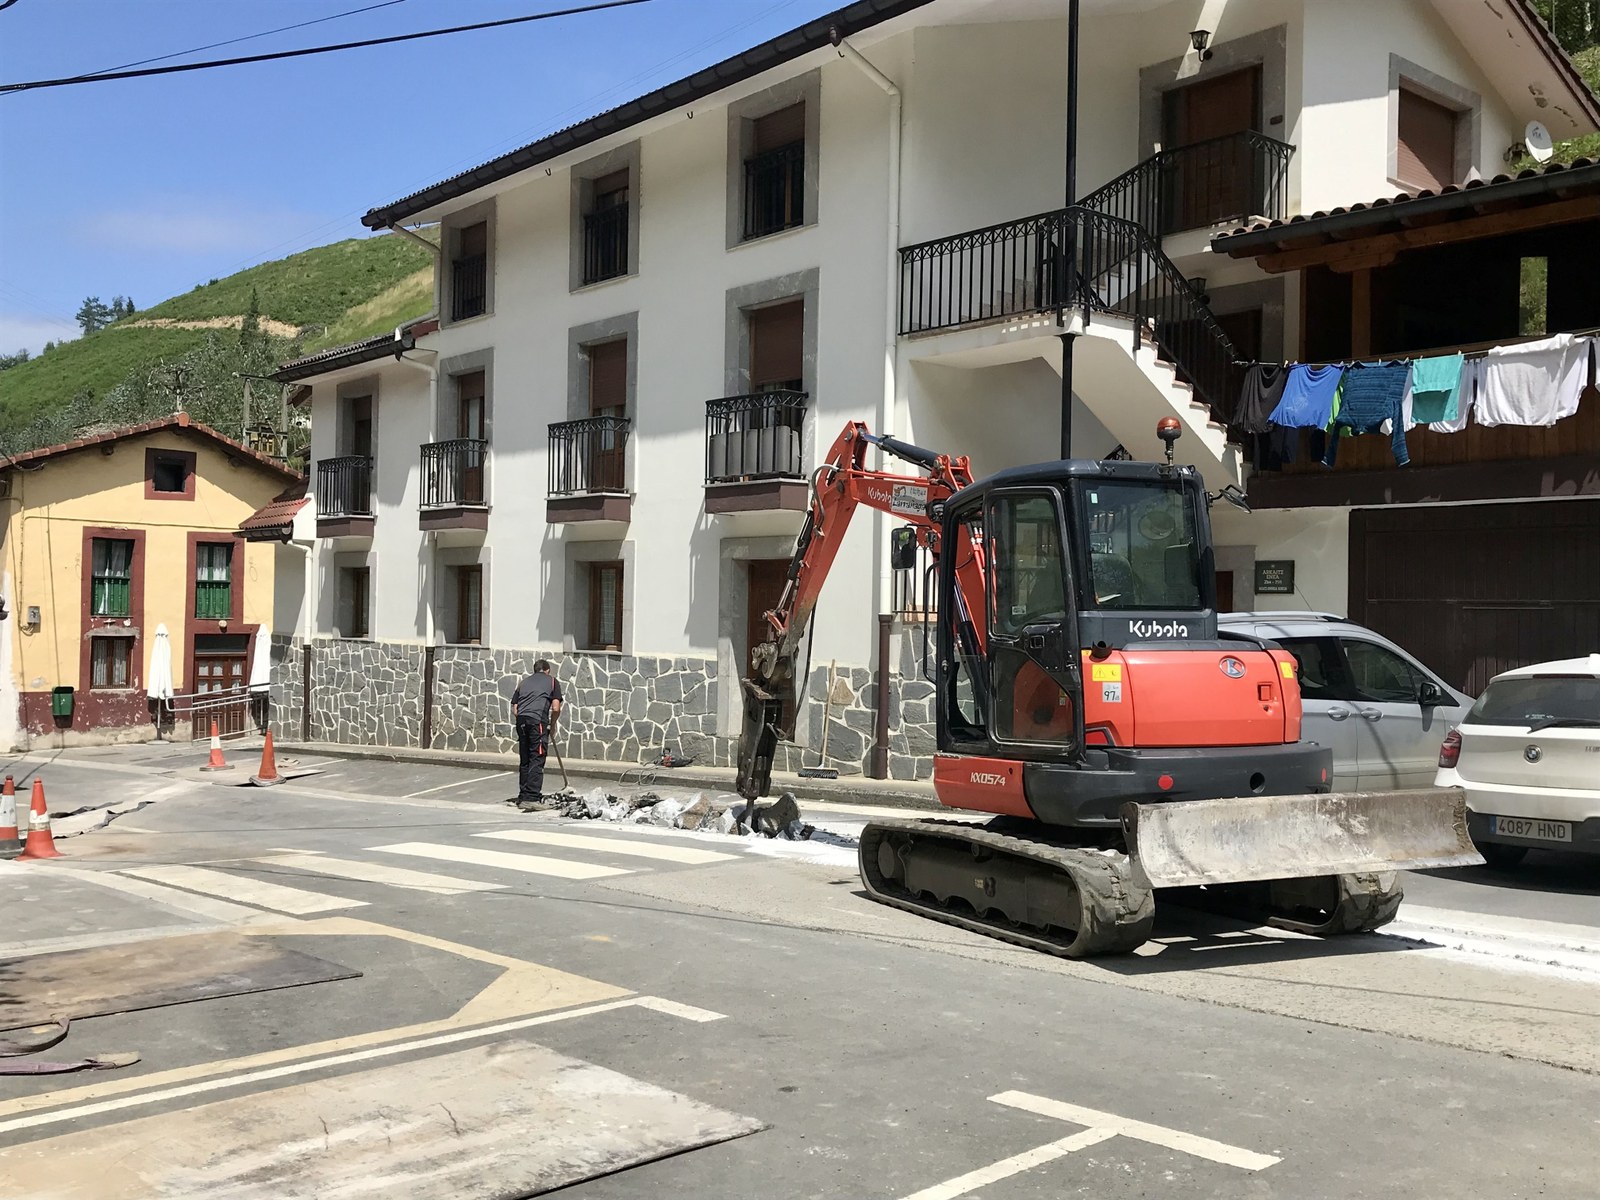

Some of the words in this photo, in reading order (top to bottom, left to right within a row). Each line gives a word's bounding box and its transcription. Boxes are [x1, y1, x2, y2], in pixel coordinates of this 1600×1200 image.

[867, 486, 892, 504] Kubota
[1129, 620, 1188, 637] Kubota
[1104, 690, 1116, 701] 97
[1498, 819, 1532, 835] 4087
[1537, 823, 1566, 839] HND
